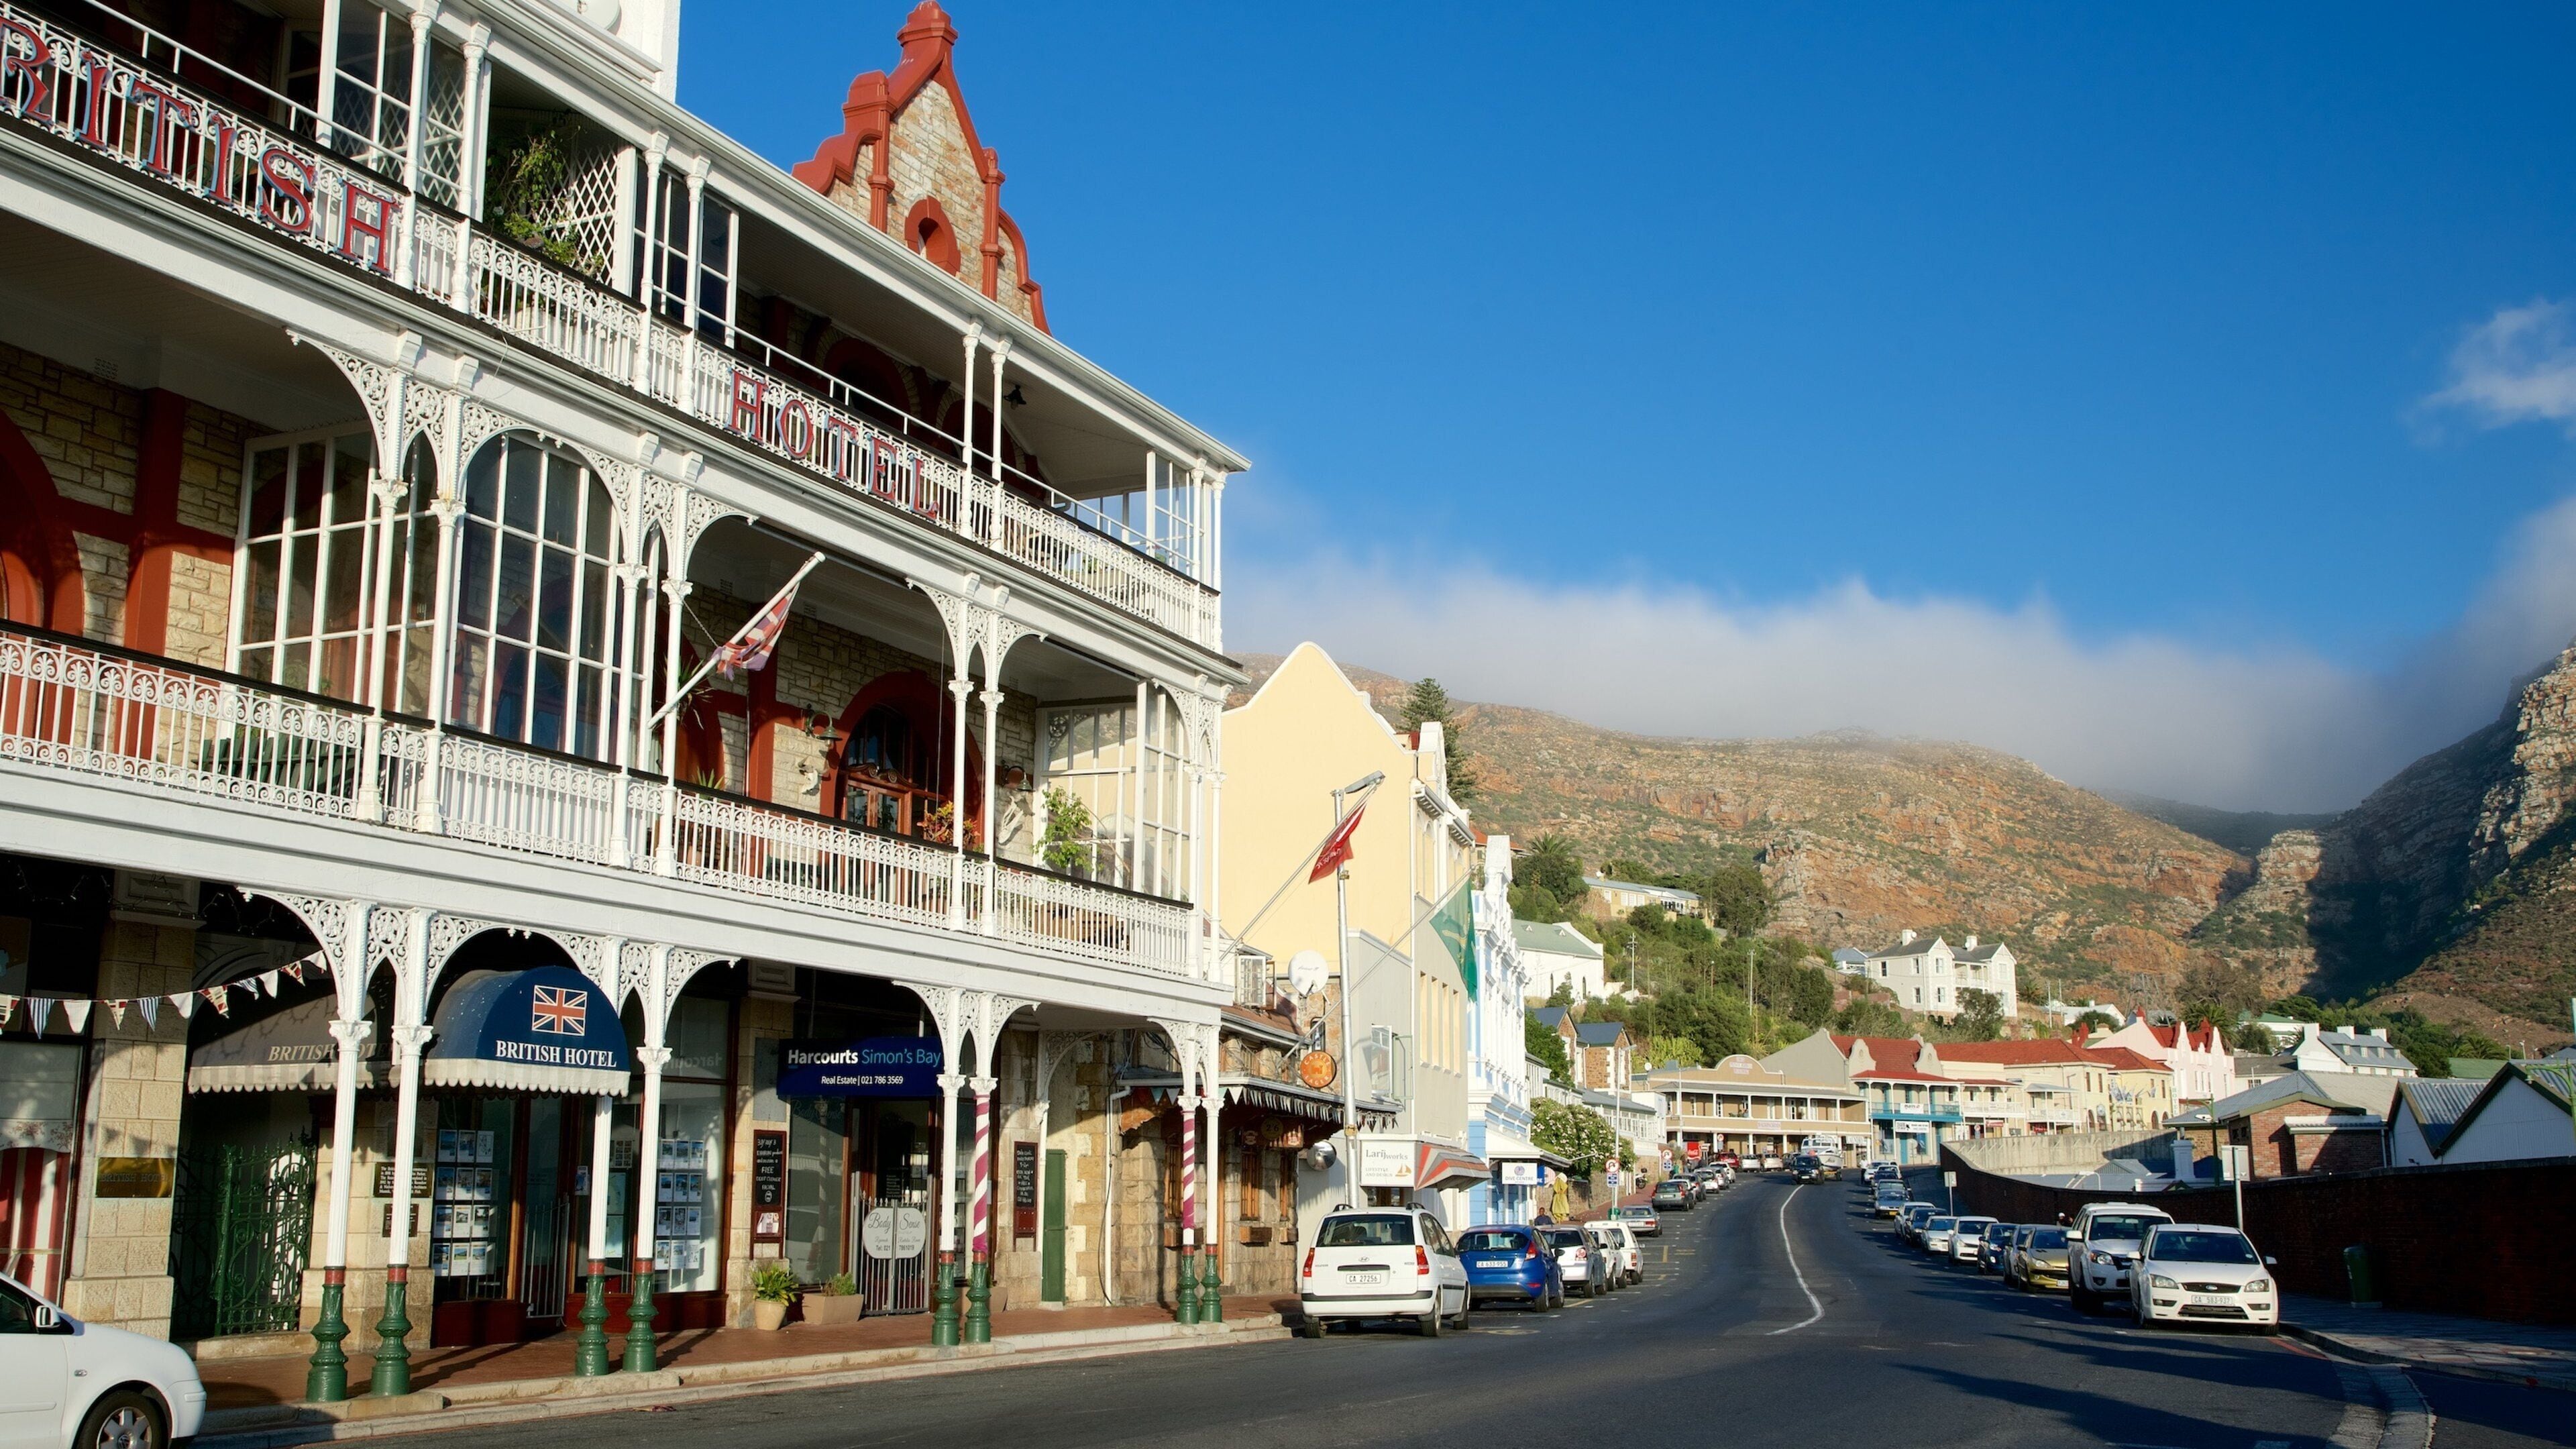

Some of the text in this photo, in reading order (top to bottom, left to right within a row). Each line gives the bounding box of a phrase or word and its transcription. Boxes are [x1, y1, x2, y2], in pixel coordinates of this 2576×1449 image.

[724, 365, 939, 522] HOTEL
[495, 1040, 616, 1067] BRITISH HOTEL
[788, 1049, 941, 1067] Harcourts Simon's Bay
[1304, 1053, 1330, 1065] CASTLE
[821, 1076, 903, 1084] Real Estate 021 786 3569
[1305, 1075, 1330, 1085] LAGER
[101, 1173, 137, 1182] BRITISH
[868, 1212, 920, 1234] Body Sense
